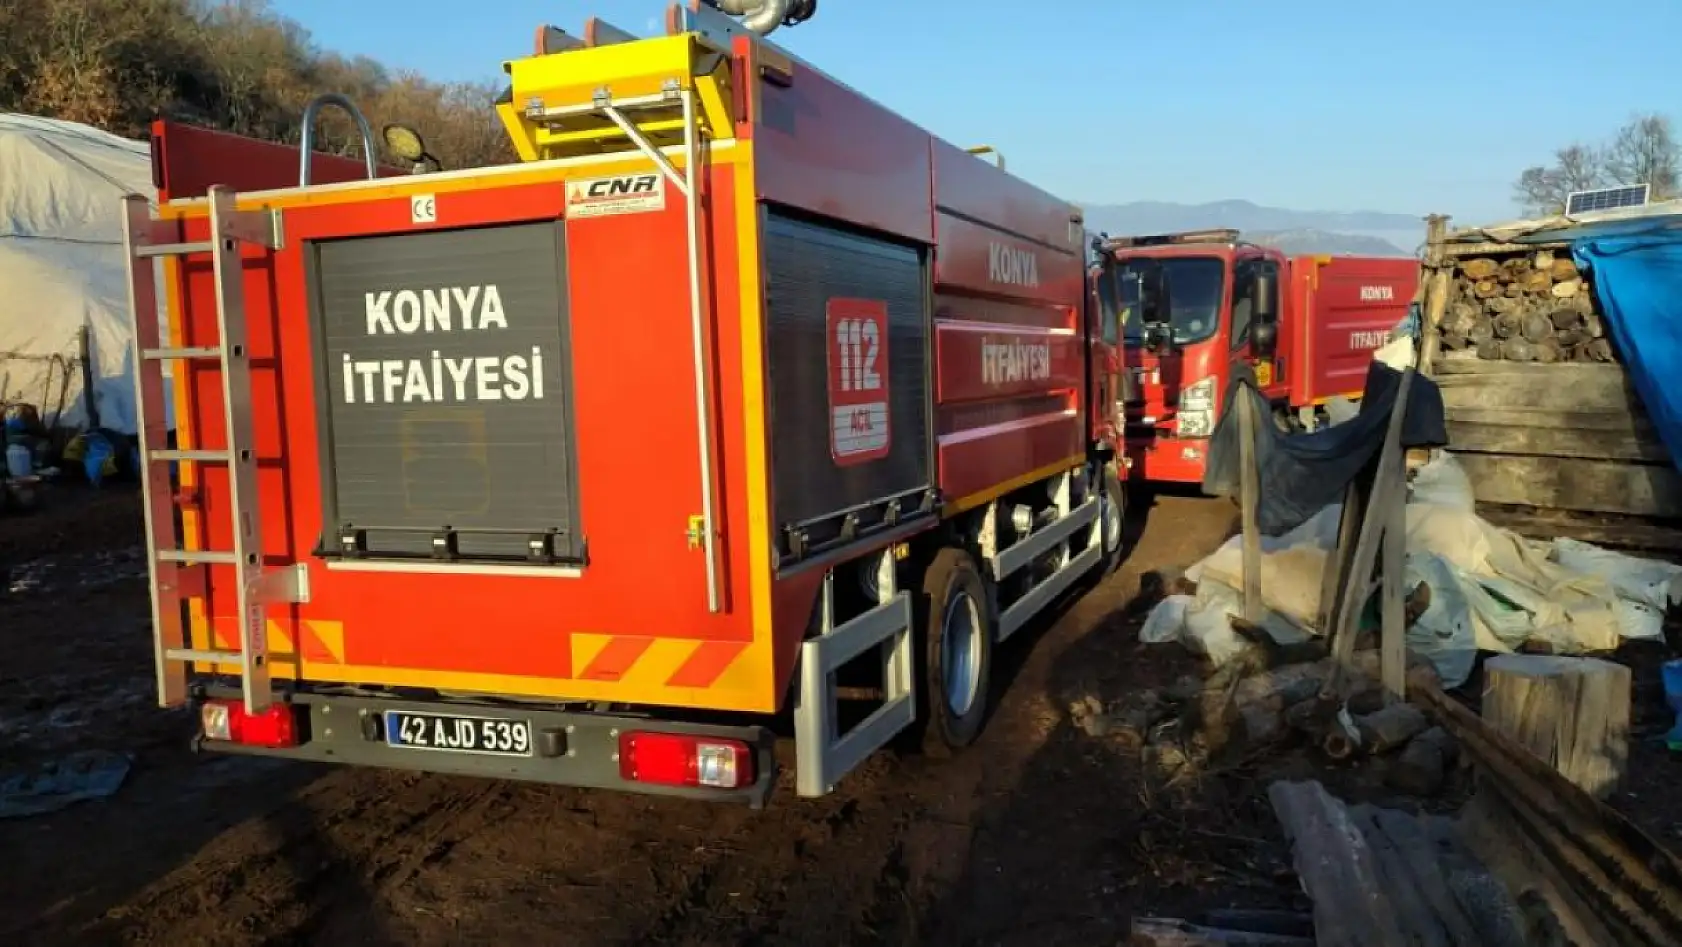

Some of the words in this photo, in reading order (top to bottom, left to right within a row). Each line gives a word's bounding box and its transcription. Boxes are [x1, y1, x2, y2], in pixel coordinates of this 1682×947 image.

[989, 242, 1038, 288] KONYA
[365, 284, 508, 335] KONYA
[1360, 285, 1393, 300] KONYA
[342, 346, 544, 404] İTFAİYESİ
[836, 318, 881, 391] 112
[981, 336, 1050, 384] İTFAİYESİ
[400, 716, 428, 745] 42
[434, 718, 475, 748] AJD
[482, 721, 528, 752] 539
